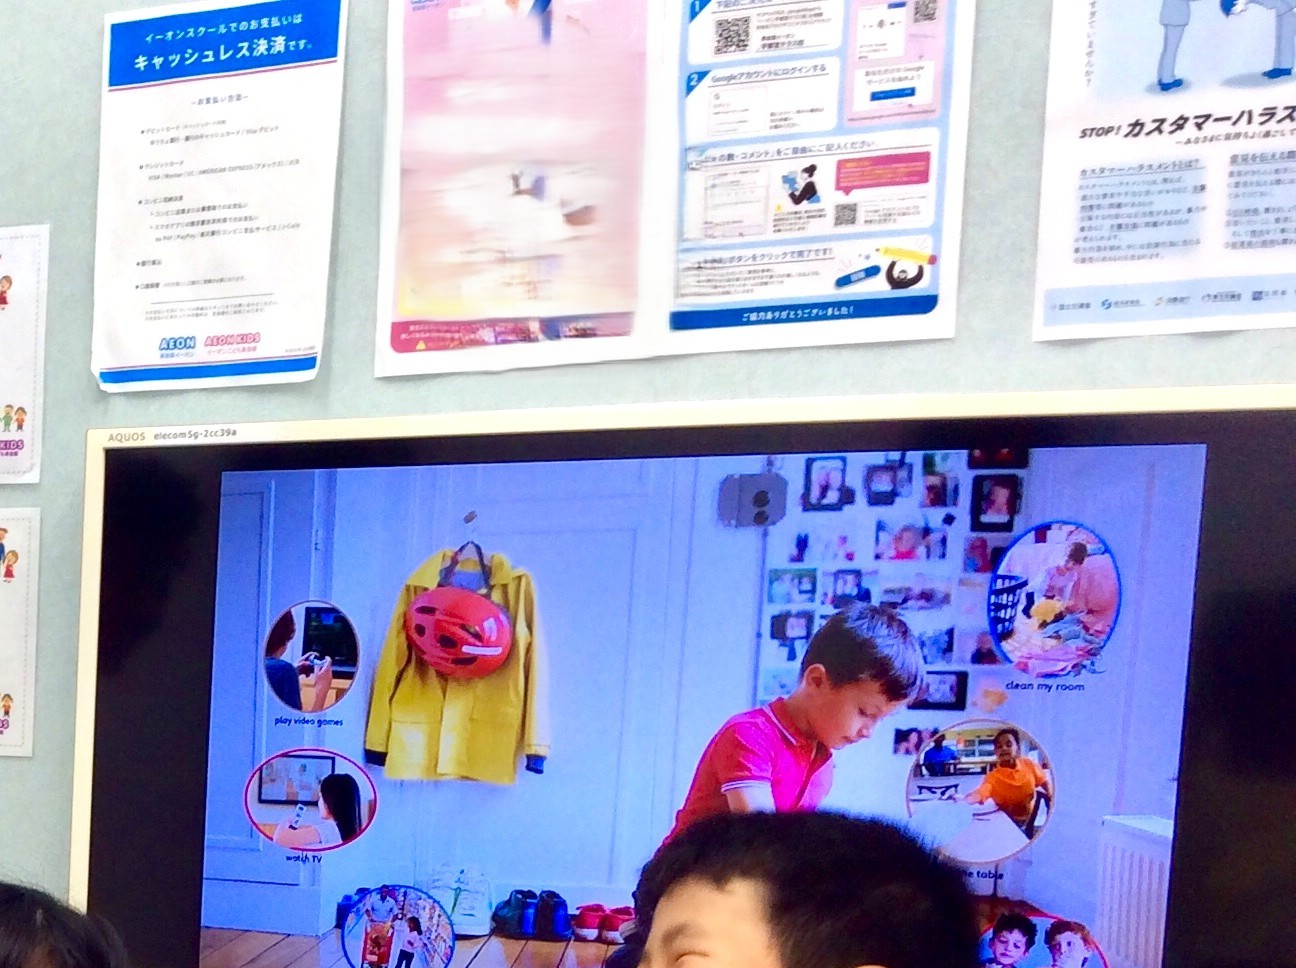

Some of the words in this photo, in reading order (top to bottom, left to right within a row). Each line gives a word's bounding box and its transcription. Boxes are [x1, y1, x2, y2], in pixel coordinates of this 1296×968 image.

[145, 13, 303, 44] イーオンスクールでのお支払いは
[134, 34, 313, 71] キャッシュレス決済です。
[689, 74, 698, 86] 2
[1079, 126, 1121, 139] STOP!
[159, 335, 196, 351] AEON
[204, 334, 235, 347] AEON
[236, 332, 261, 345] KIDS
[107, 432, 146, 443] AQUOS
[0, 439, 24, 451] KIDS
[1005, 680, 1034, 690] clean
[1037, 683, 1053, 693] my
[1056, 683, 1085, 691] room
[274, 716, 292, 728] play
[293, 716, 315, 726] video
[317, 717, 343, 728] games
[285, 853, 307, 863] watch
[312, 855, 323, 863] TV
